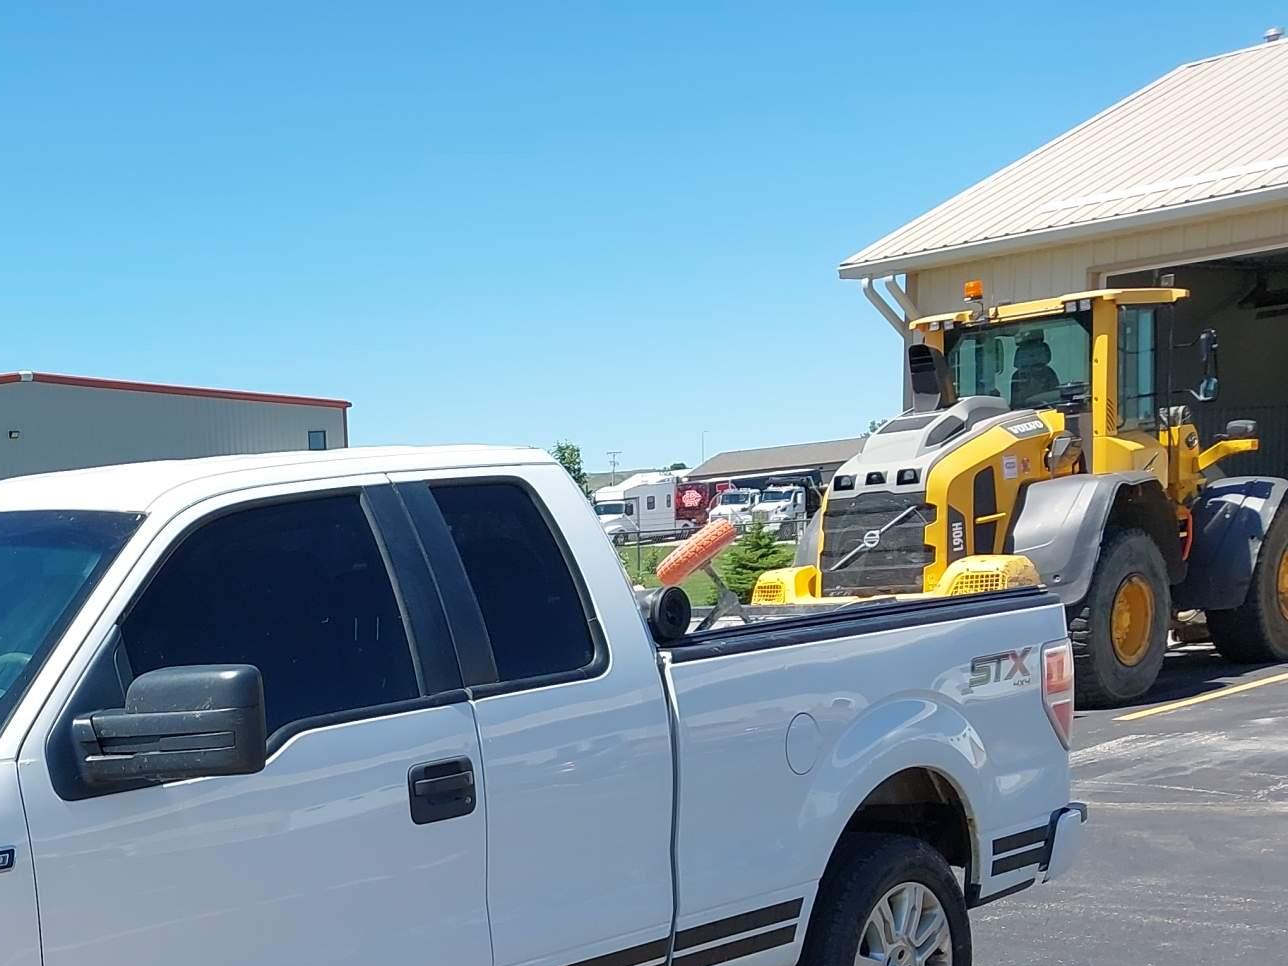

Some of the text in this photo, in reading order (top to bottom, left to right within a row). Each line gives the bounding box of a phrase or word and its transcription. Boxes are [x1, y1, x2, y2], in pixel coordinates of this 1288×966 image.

[1007, 419, 1044, 434] VOLVO
[952, 522, 964, 552] L90H
[969, 646, 1033, 688] STX
